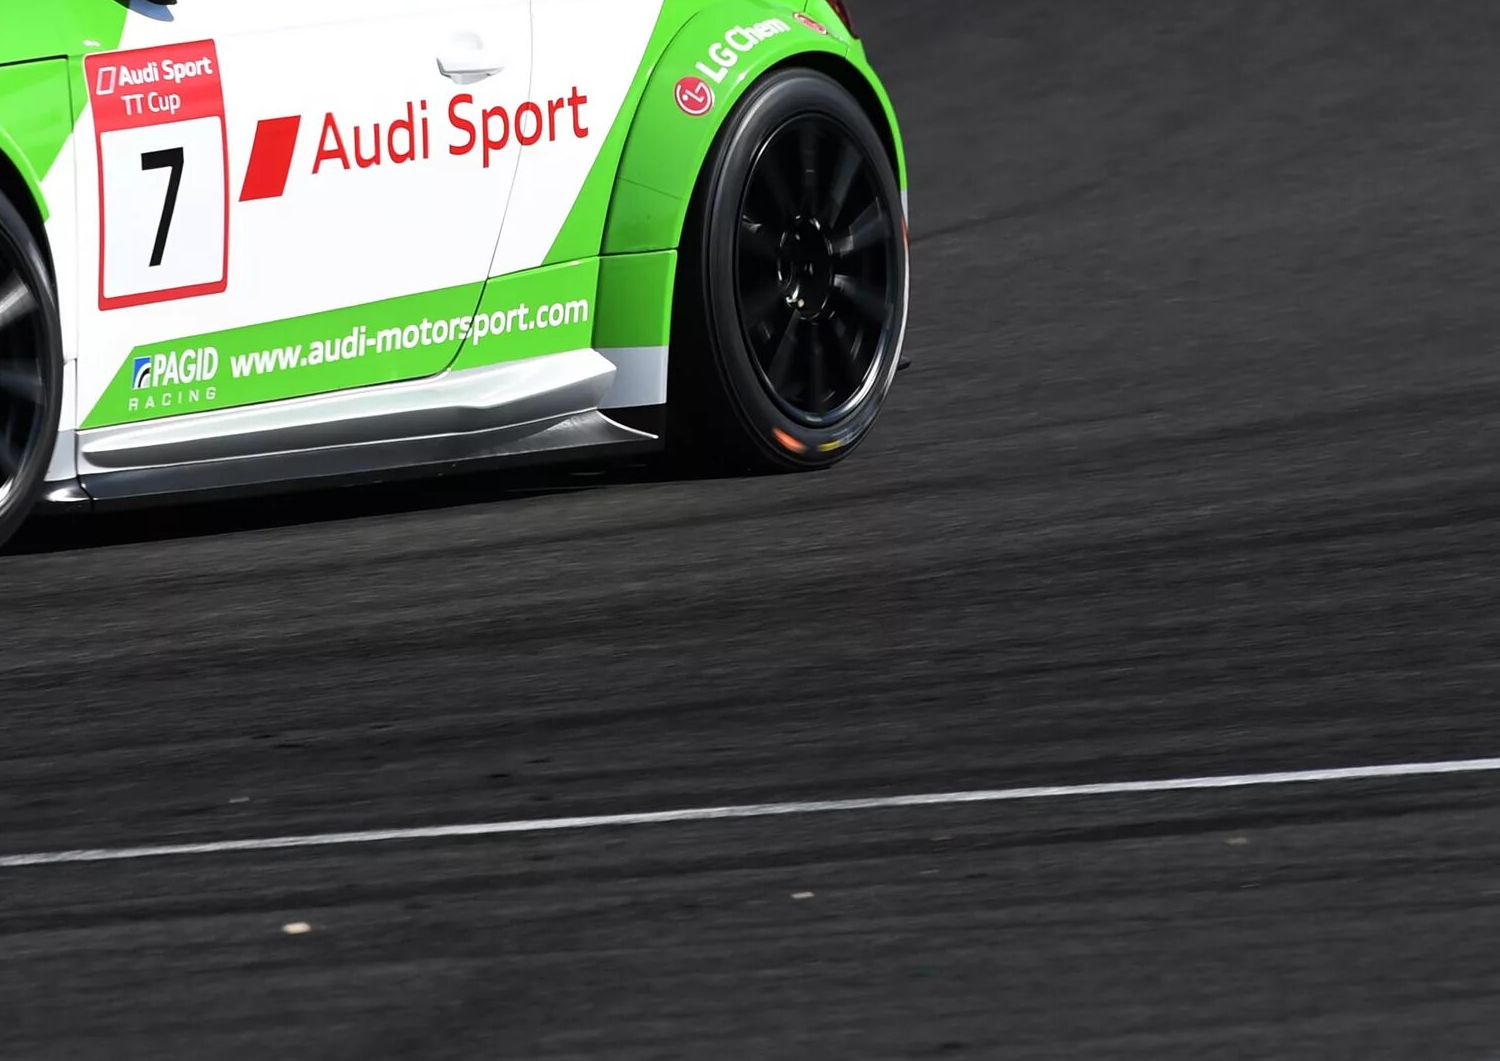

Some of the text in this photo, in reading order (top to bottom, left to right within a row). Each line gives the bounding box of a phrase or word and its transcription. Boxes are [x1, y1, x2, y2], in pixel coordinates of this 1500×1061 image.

[118, 56, 213, 88] Audi Sport
[695, 18, 792, 85] LG Chem
[121, 91, 182, 116] TT Cup
[312, 84, 591, 175] Audi Sport
[140, 146, 185, 268] 7
[229, 297, 589, 379] www.audi-motorsport.com
[152, 346, 219, 388] PAGID
[128, 386, 218, 412] RACING
